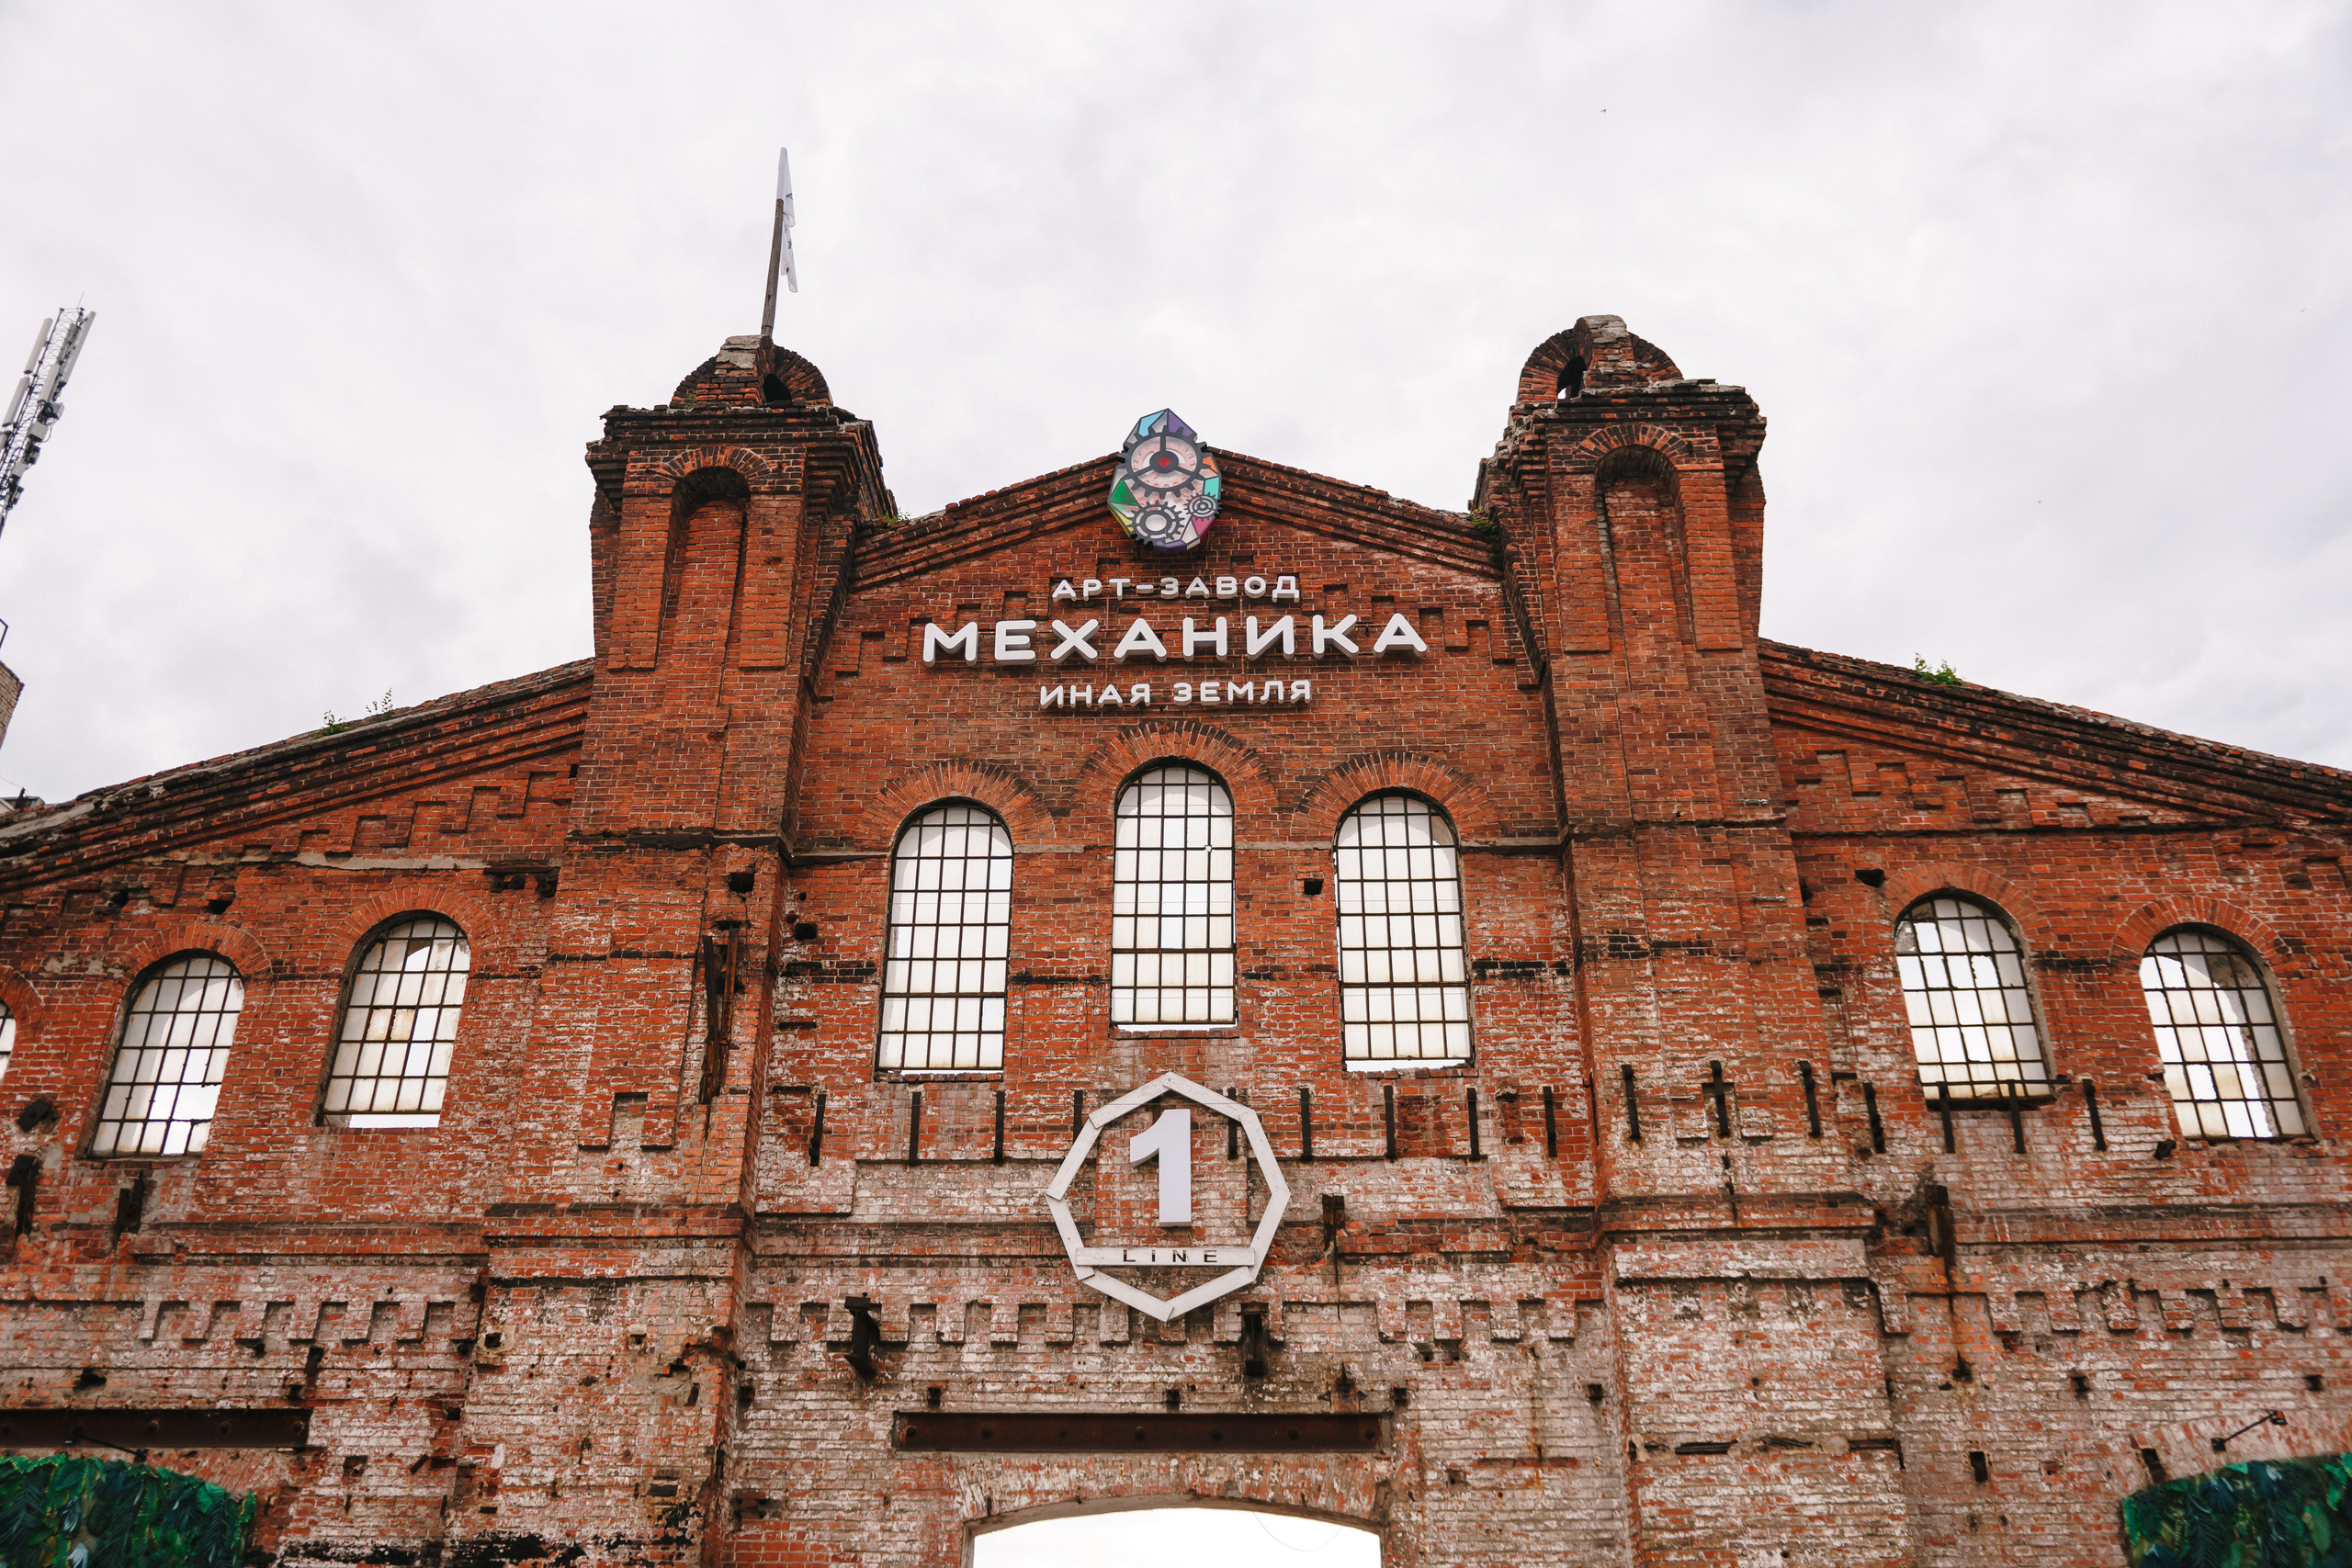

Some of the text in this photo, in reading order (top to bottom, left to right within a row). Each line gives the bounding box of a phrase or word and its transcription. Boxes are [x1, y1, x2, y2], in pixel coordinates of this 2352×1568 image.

[1051, 575, 1300, 602] АРТ-ЗАВОД
[922, 613, 1428, 667] МЕХАНИКА
[1039, 680, 1312, 709] ИНАЯ ЗЕМЛЯ
[1130, 1109, 1192, 1227] 1
[1123, 1249, 1217, 1263] LINE
